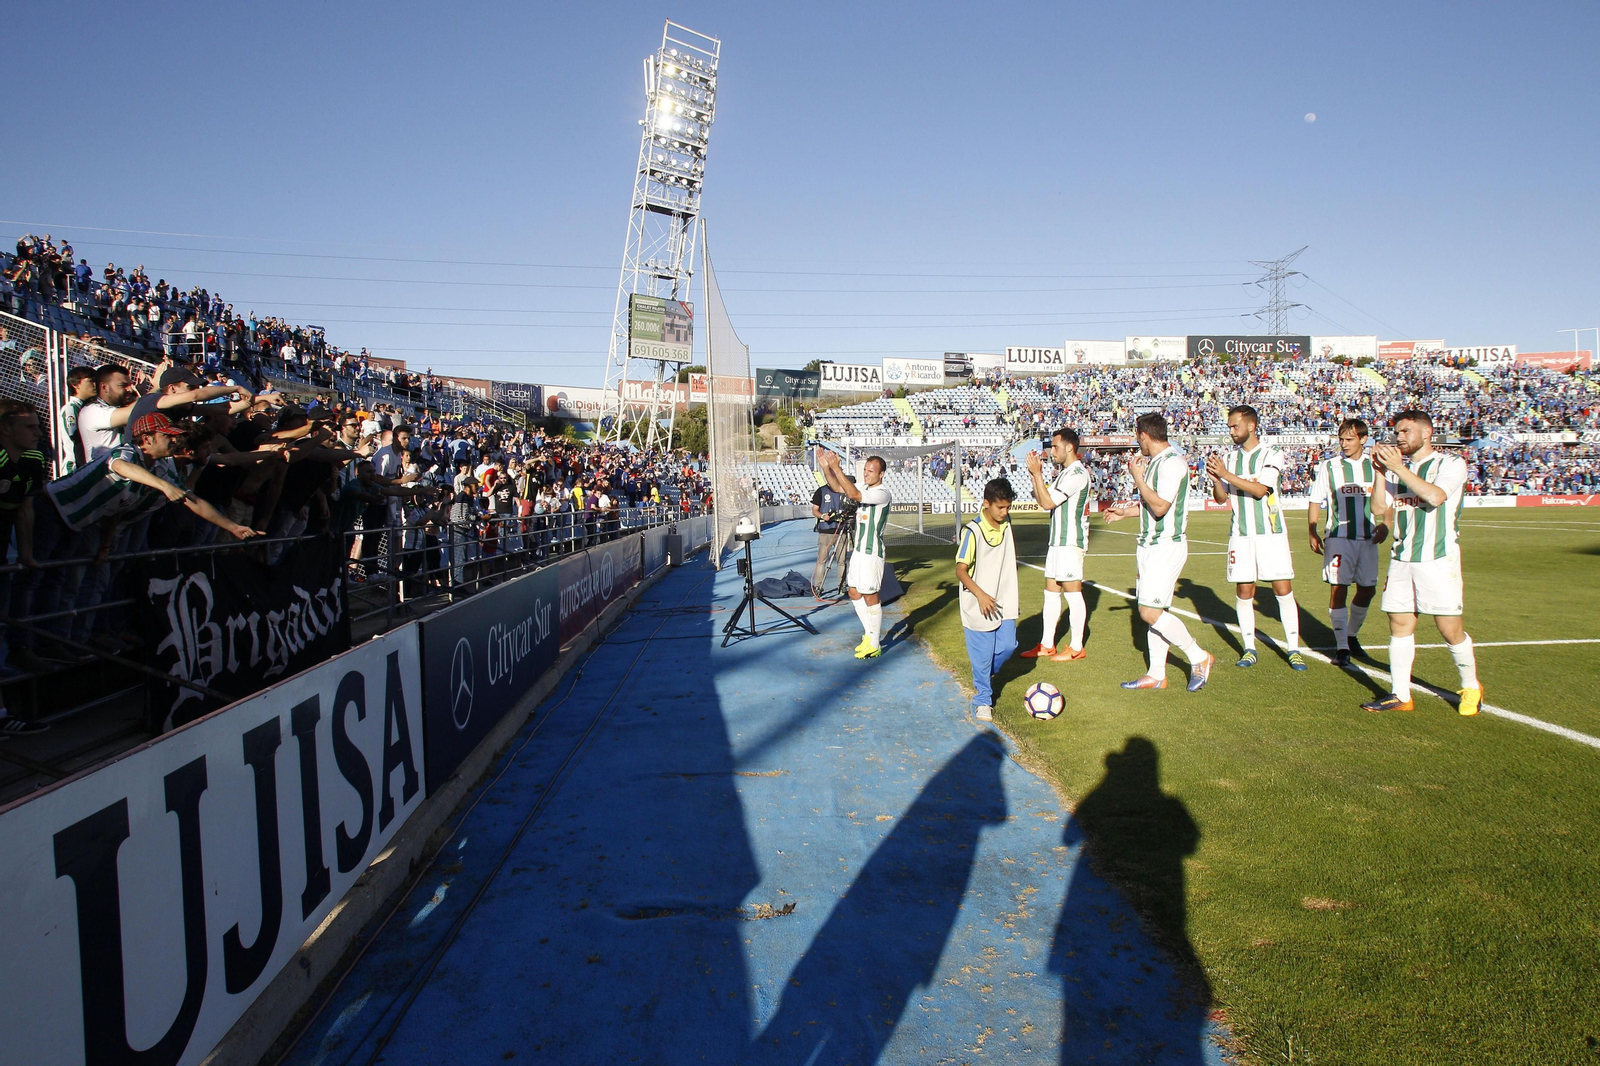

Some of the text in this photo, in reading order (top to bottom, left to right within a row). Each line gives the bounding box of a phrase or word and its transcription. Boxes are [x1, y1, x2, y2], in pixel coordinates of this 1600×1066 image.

[634, 344, 650, 356] 691
[652, 346, 670, 358] 605
[672, 348, 689, 360] 368
[1225, 340, 1273, 355] Citycar
[1007, 348, 1063, 364] LUJISA
[904, 362, 937, 372] Antonio
[821, 365, 881, 383] LUJISA
[911, 370, 942, 380] Ricardo
[502, 389, 530, 398] LAGOM
[558, 399, 608, 411] RolDigitl
[864, 437, 897, 446] LUJISA
[1277, 436, 1307, 444] LUJISA
[1009, 503, 1039, 511] NKERS
[559, 581, 580, 622] AUTOS
[488, 597, 552, 685] Citycar Sur
